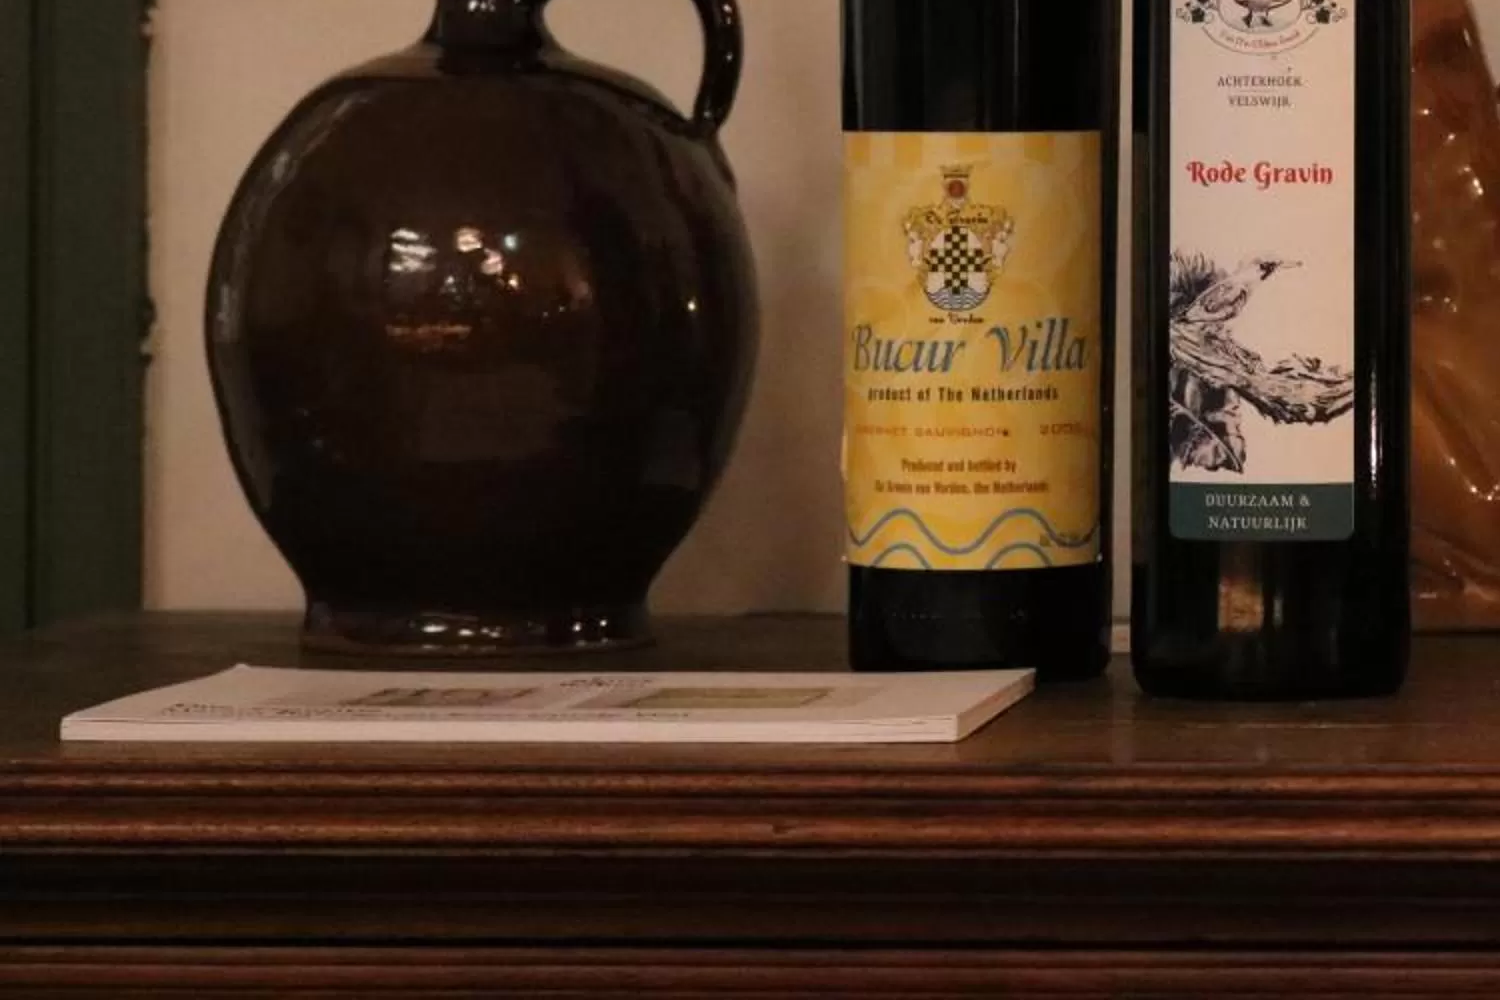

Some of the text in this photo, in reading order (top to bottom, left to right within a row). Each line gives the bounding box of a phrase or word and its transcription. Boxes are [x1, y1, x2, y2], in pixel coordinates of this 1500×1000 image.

[1217, 76, 1302, 87] ACHTERHOEK
[1227, 95, 1290, 108] VELSWIJK
[1185, 160, 1334, 190] Rode Gravin
[851, 316, 1089, 374] Bucur Villa
[917, 387, 931, 400] of
[938, 387, 963, 402] The
[971, 386, 1059, 401] Netherlands
[1205, 493, 1294, 507] DUURZAAM
[1208, 516, 1308, 532] NATUURLIJK
